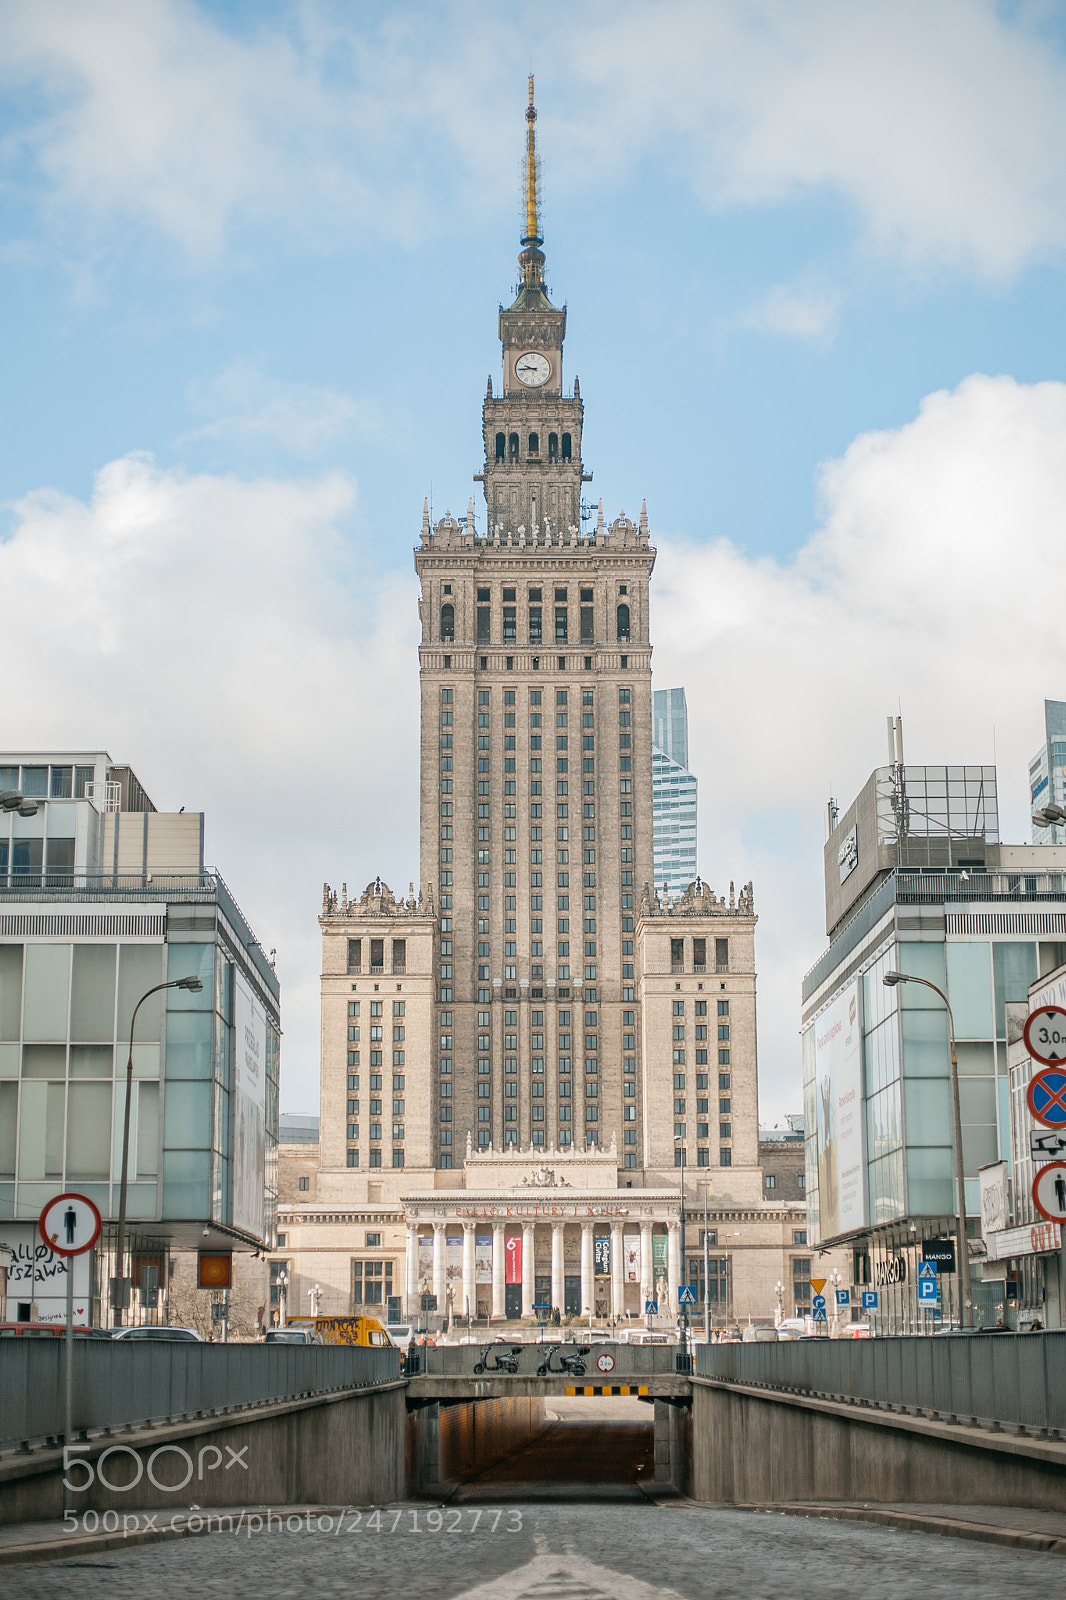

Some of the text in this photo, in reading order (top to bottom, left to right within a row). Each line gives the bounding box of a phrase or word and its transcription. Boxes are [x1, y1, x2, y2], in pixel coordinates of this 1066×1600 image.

[506, 1207, 566, 1216] KULTURY
[875, 1257, 901, 1286] MANGO
[922, 1282, 933, 1297] P
[838, 1291, 847, 1303] P
[865, 1293, 875, 1306] P
